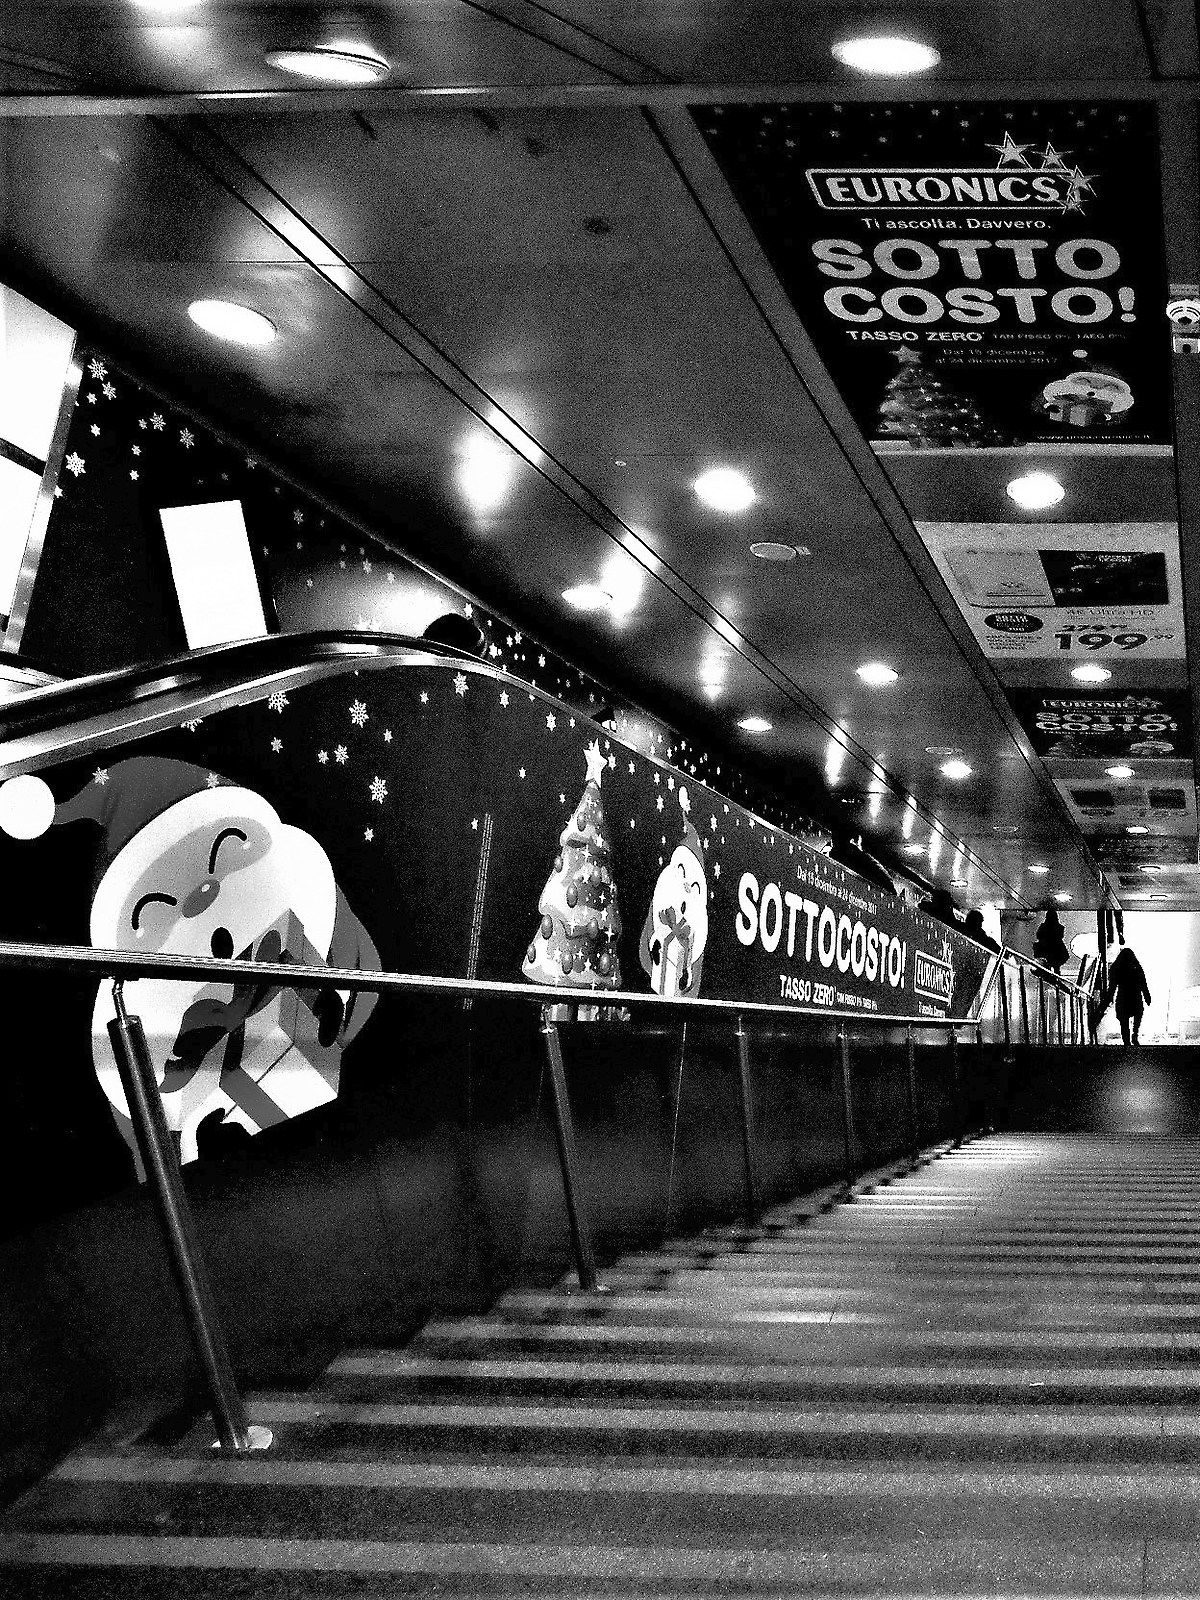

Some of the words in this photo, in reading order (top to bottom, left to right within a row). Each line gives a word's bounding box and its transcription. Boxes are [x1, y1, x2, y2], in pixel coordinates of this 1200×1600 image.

[824, 176, 1060, 203] EURONICS
[861, 218, 881, 230] Ti
[886, 217, 963, 231] ascolta.
[967, 217, 1052, 231] Davvero.
[811, 238, 1121, 280] SOTTO
[822, 285, 1137, 324] COSTO!
[845, 331, 919, 342] TASSO
[1035, 721, 1179, 732] COSTO!
[1036, 712, 1173, 723] SOTTO
[735, 871, 908, 990] SOTTOCOSTO!
[779, 974, 812, 1002] TASSO
[917, 959, 950, 994] EURONICS
